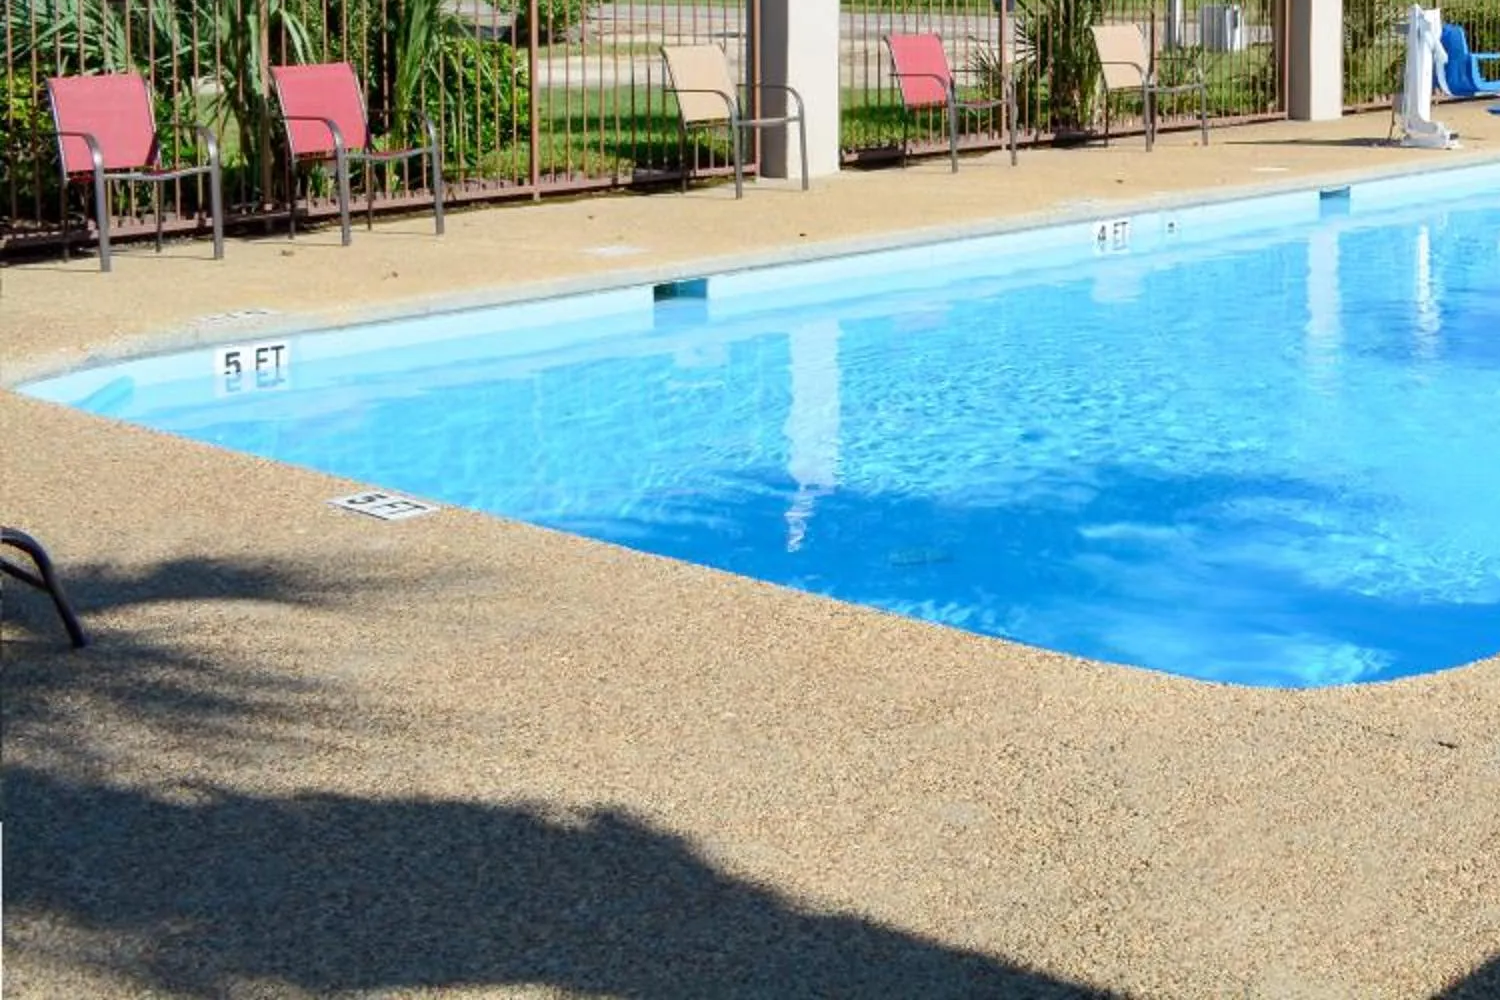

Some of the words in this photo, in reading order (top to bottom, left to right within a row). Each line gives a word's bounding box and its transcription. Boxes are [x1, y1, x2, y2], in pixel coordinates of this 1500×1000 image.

[1097, 224, 1106, 241] 4
[1112, 221, 1129, 238] FT
[224, 352, 241, 374] 5
[256, 345, 285, 371] FT
[346, 493, 388, 505] 5
[370, 501, 428, 515] FT
